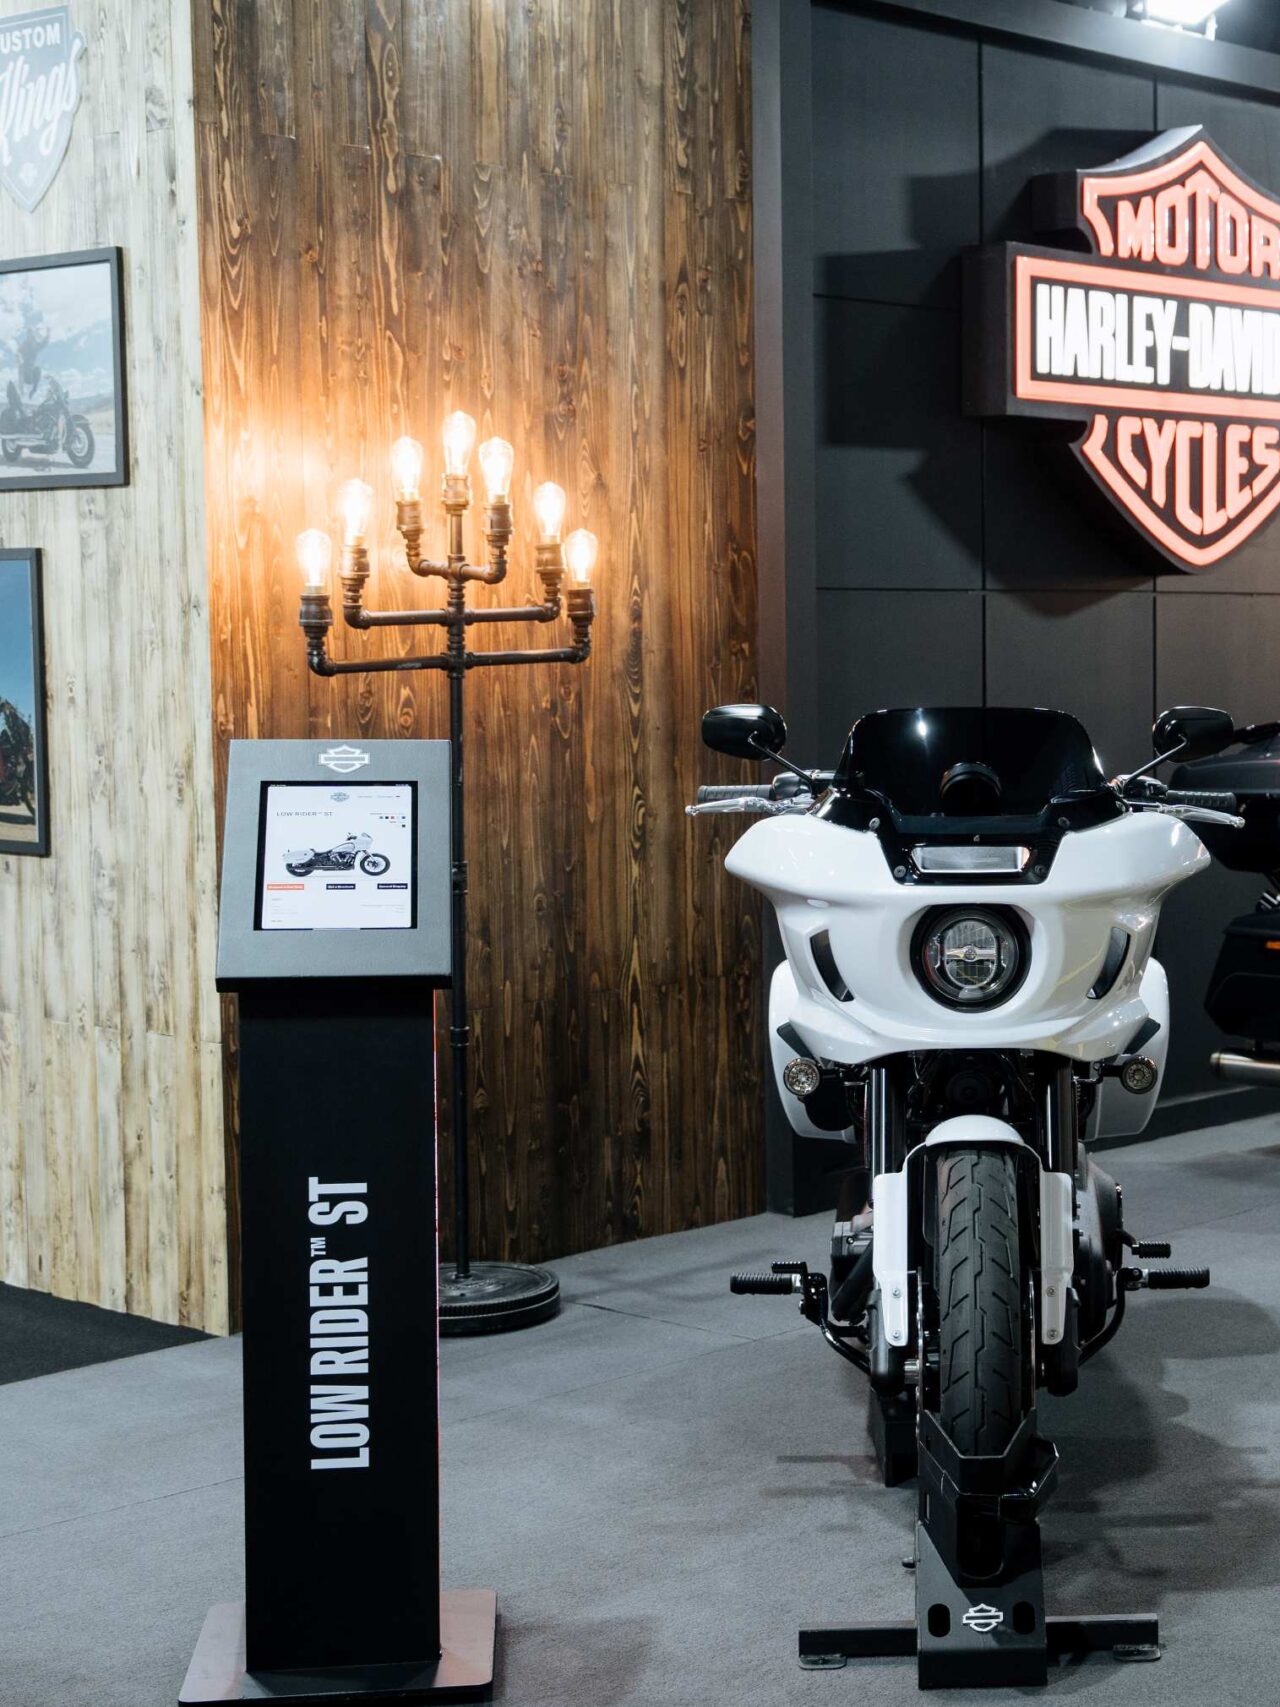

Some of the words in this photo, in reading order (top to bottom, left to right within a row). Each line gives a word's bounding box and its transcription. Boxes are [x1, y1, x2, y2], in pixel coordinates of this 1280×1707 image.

[0, 22, 61, 55] USTOM
[308, 1176, 369, 1225] ST
[310, 1384, 370, 1470] LOW
